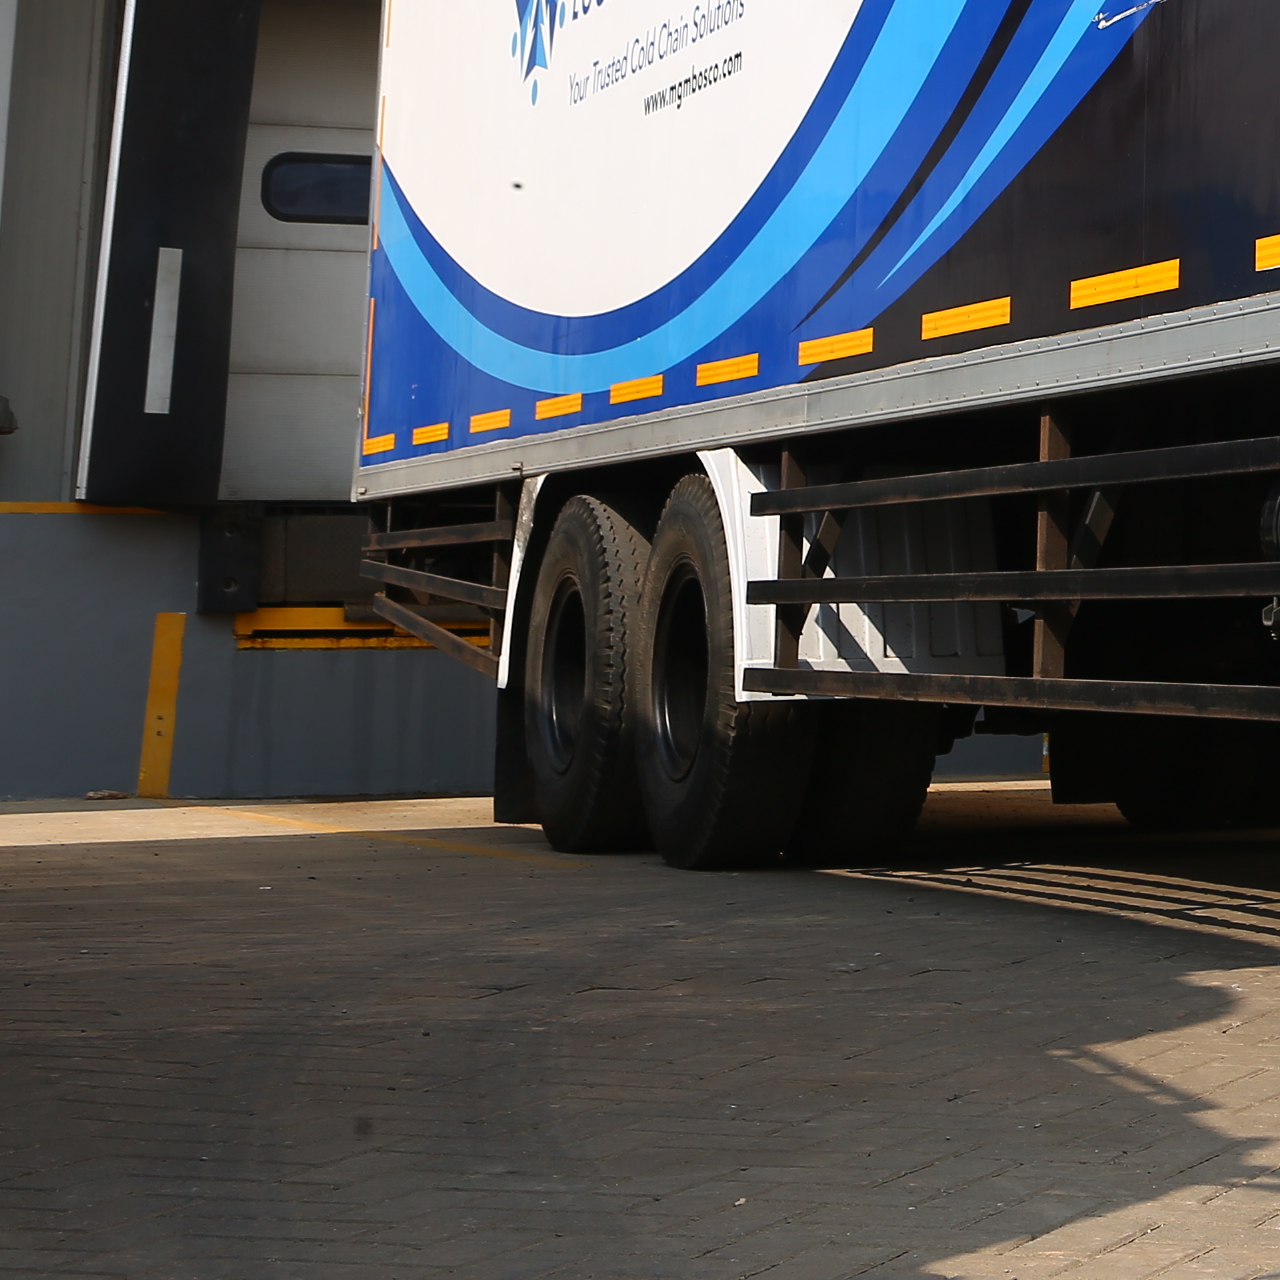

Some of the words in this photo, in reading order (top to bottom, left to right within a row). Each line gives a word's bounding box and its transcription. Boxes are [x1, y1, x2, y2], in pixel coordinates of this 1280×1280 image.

[569, 73, 590, 106] Your
[592, 41, 630, 95] Trusted
[630, 26, 656, 74] Cold
[657, 14, 689, 60] Chain
[643, 50, 742, 116] www.mgmbosco.com
